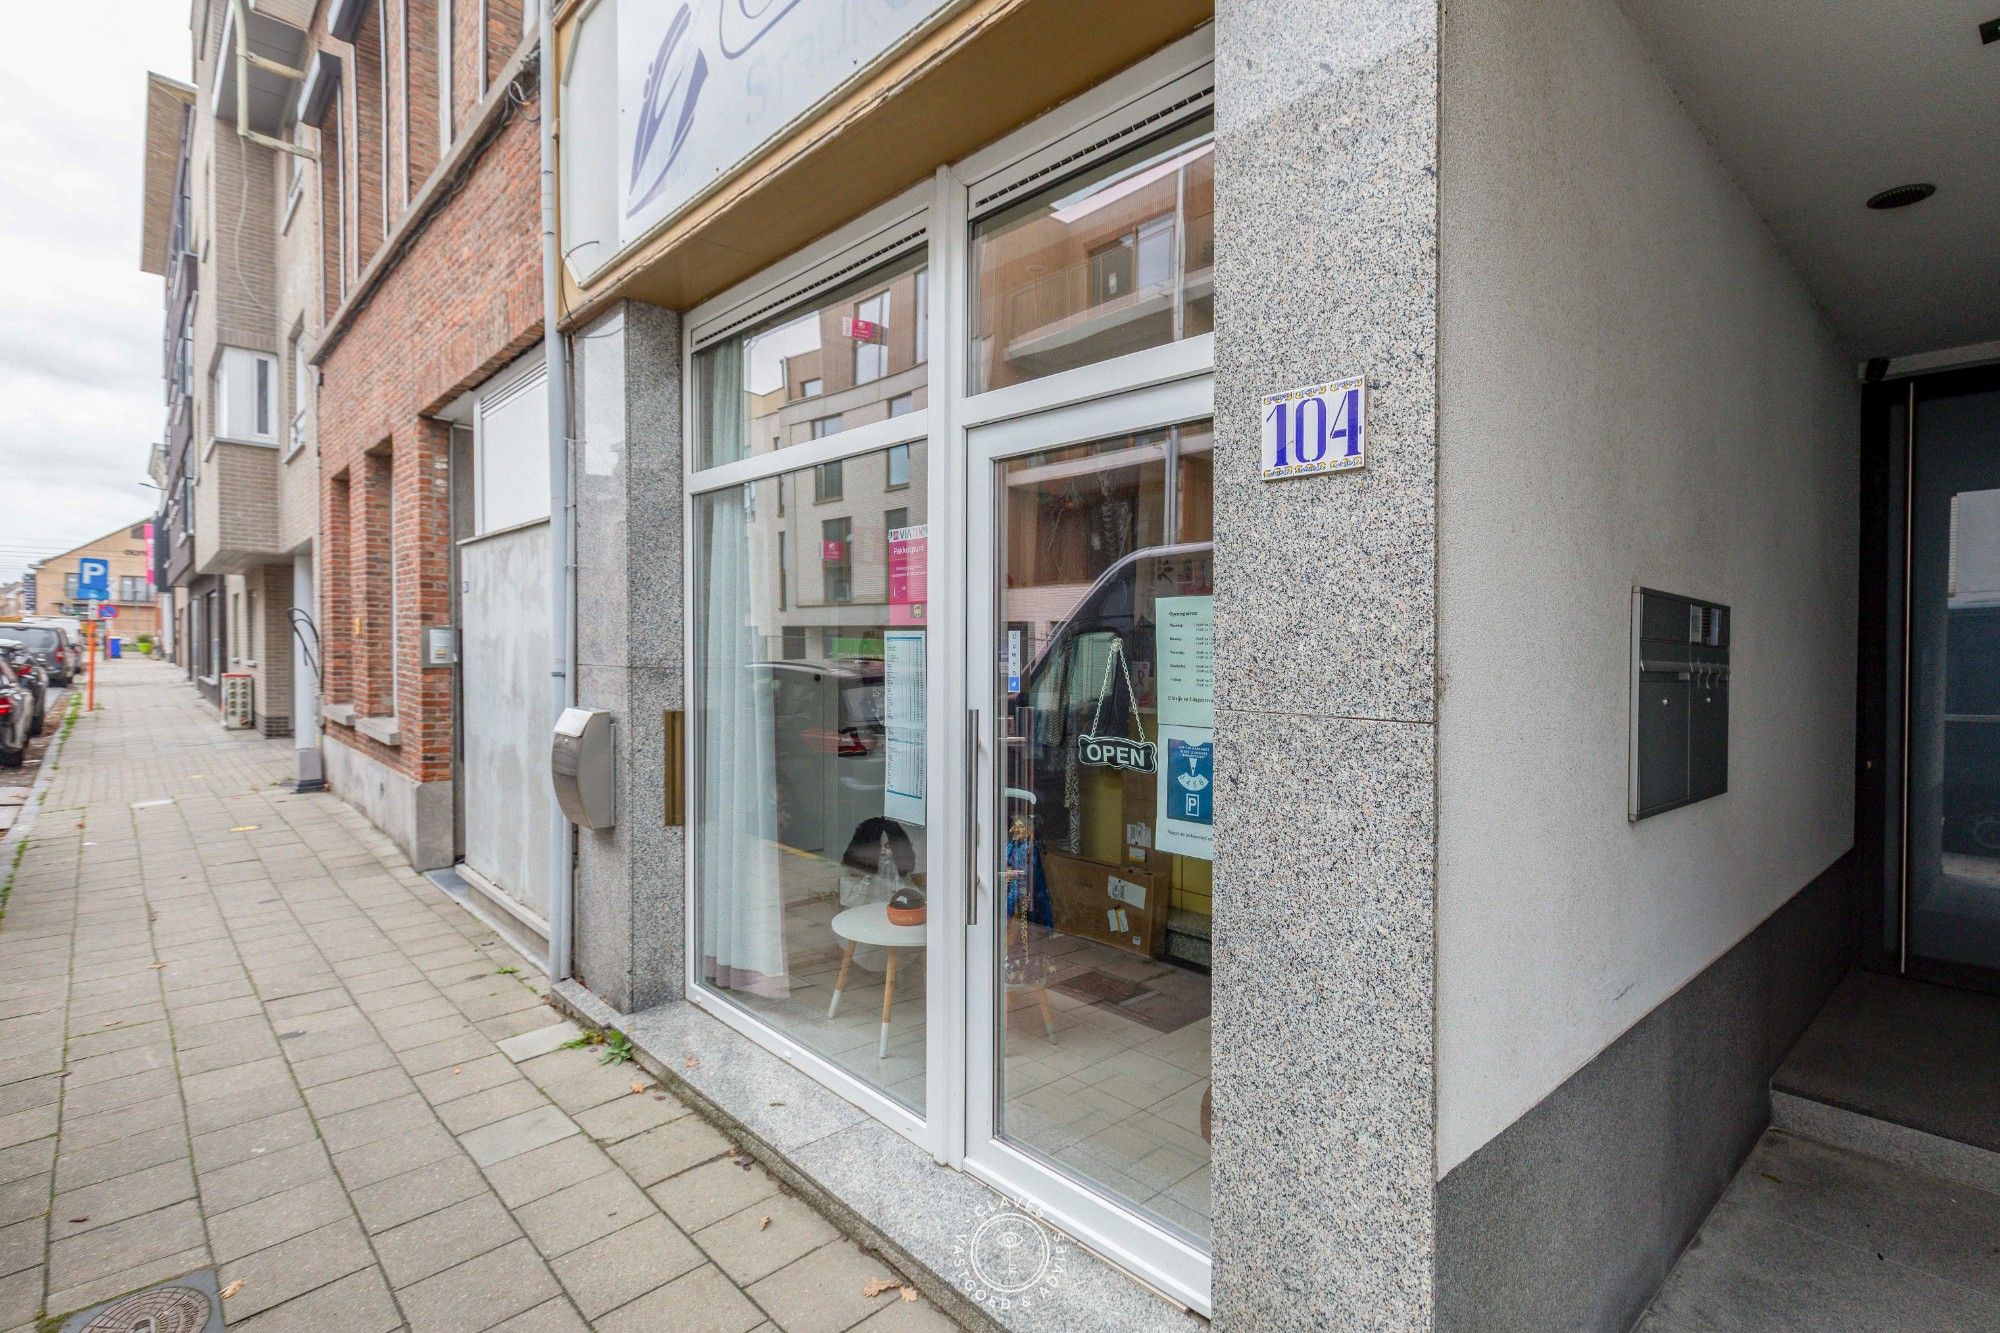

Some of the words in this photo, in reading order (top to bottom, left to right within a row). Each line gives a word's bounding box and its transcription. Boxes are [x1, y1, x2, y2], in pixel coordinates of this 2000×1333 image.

[1265, 388, 1362, 468] 104
[82, 562, 105, 584] P
[1087, 744, 1145, 767] OPEN
[1188, 797, 1197, 812] P
